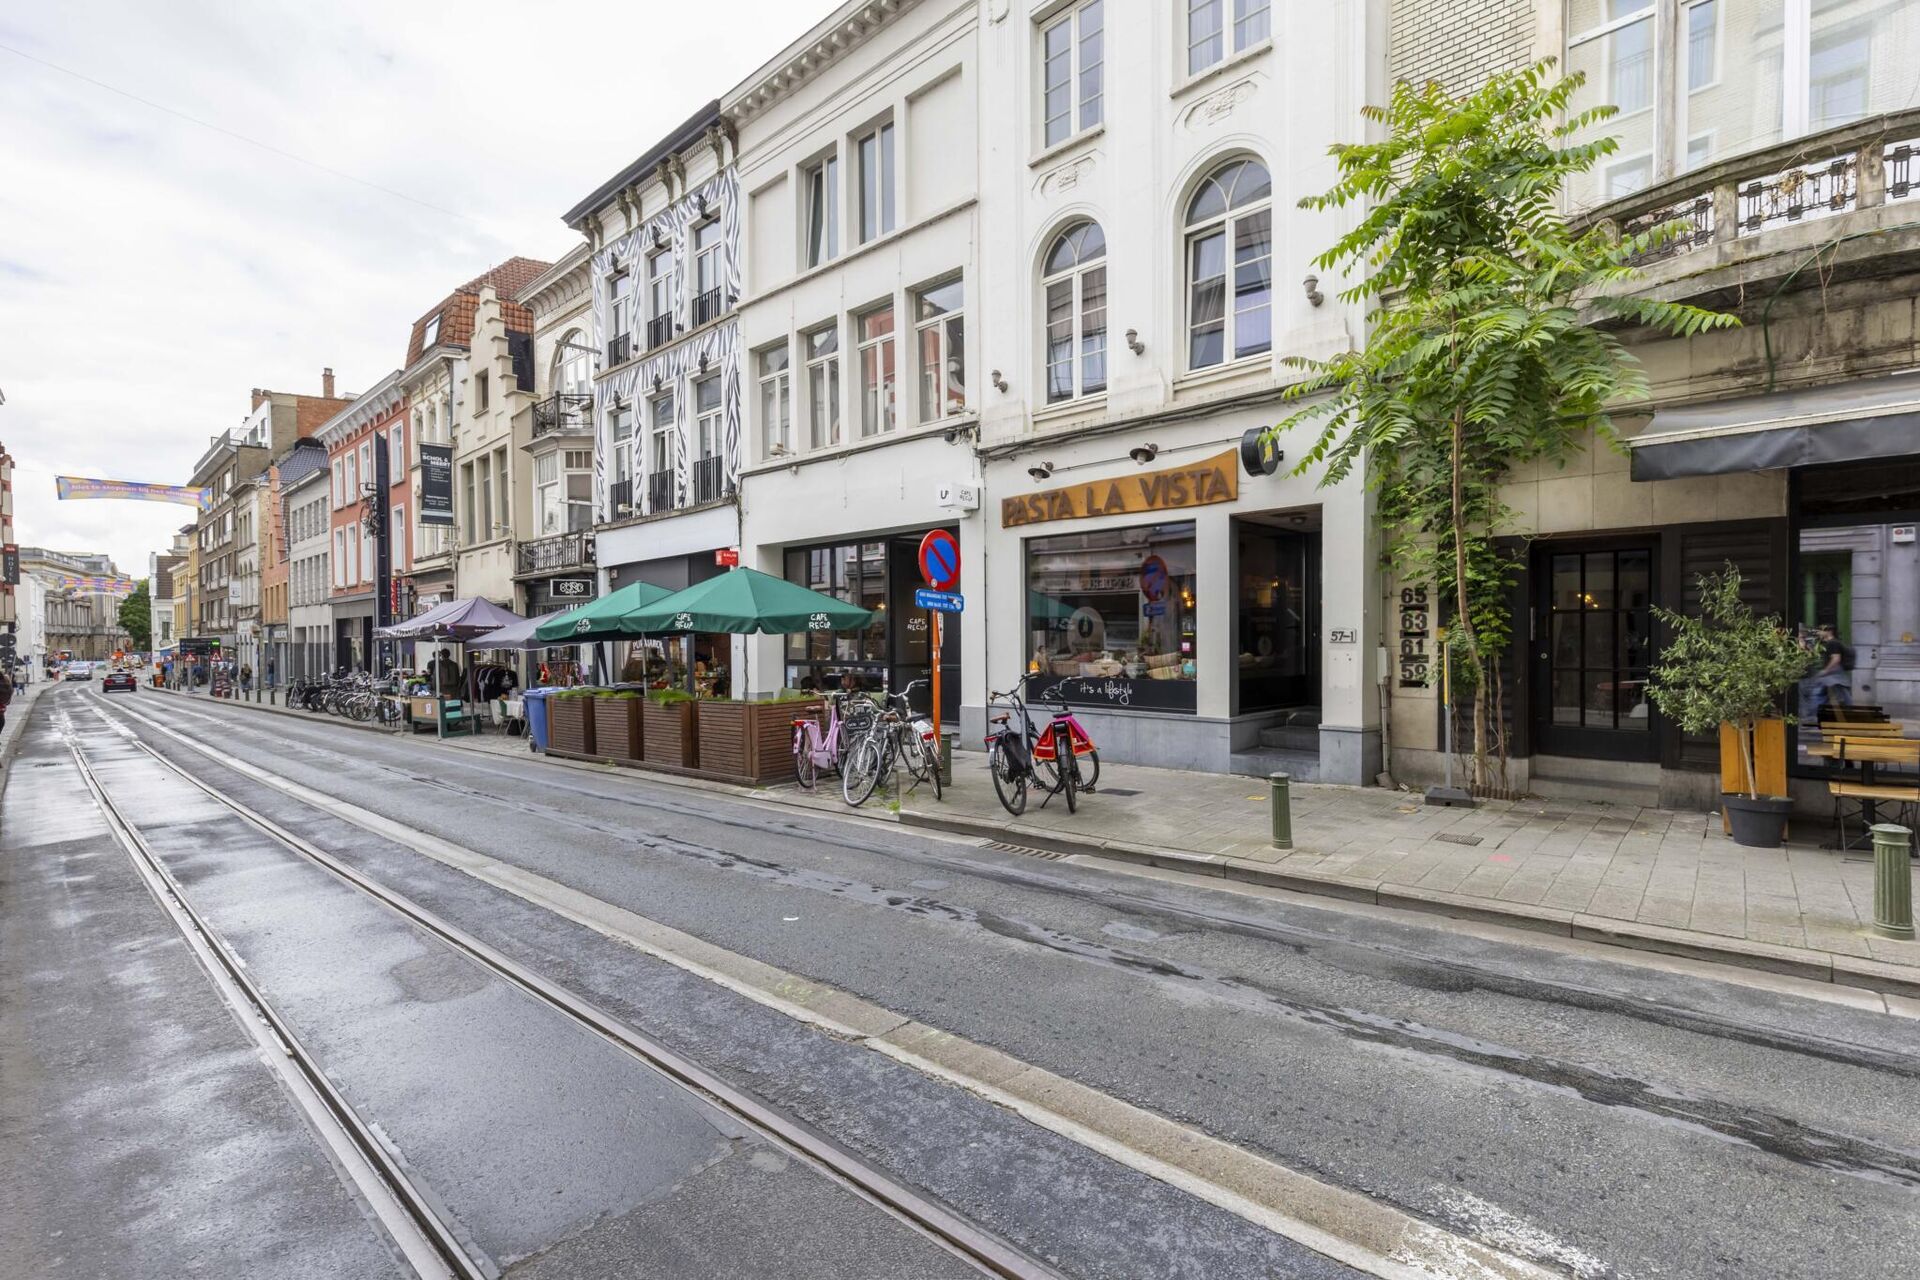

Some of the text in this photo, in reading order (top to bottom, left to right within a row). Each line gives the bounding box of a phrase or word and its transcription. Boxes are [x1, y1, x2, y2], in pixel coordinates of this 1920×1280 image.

[1003, 466, 1233, 526] PASTA LA VISTA
[1401, 587, 1427, 604] 65
[1401, 612, 1428, 630] 63
[1330, 630, 1354, 642] 57-1
[1401, 639, 1424, 655] 61
[1401, 663, 1427, 680] 59
[1080, 682, 1095, 694] it's
